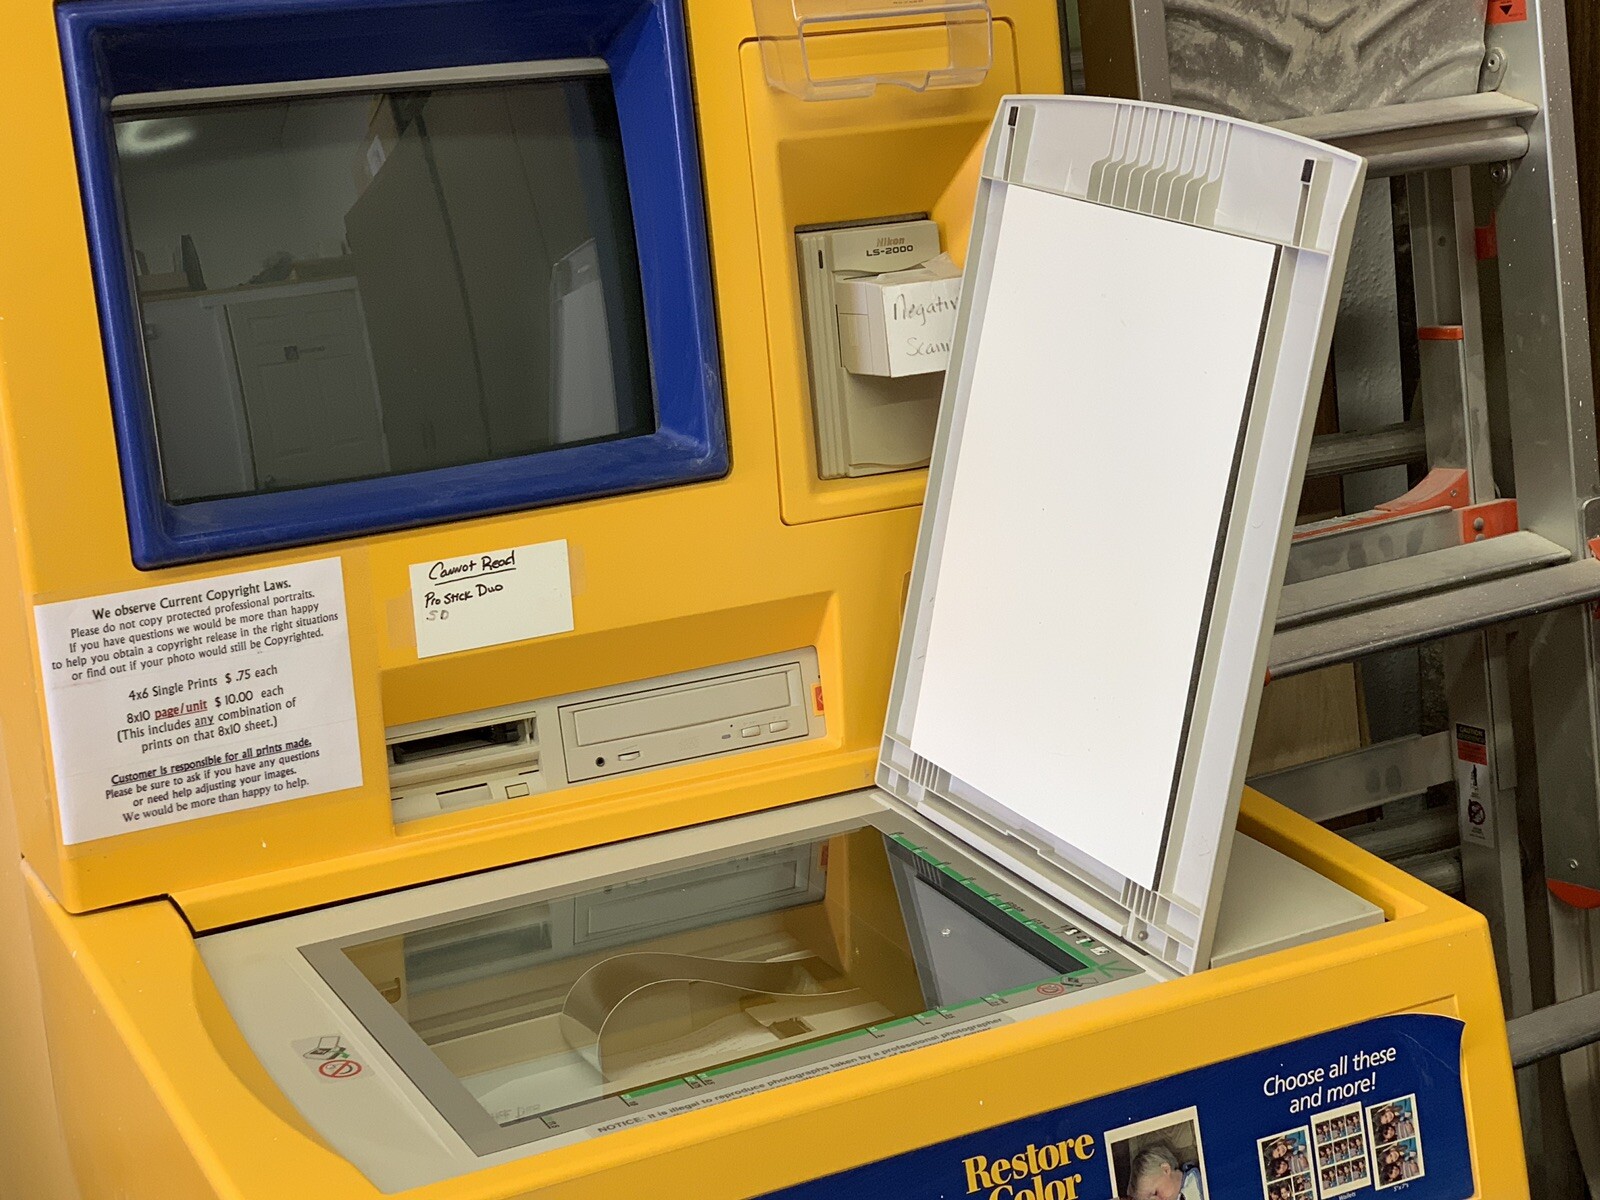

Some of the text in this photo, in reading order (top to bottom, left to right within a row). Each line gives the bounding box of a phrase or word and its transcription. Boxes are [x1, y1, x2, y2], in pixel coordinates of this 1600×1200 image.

[866, 245, 914, 257] LS-2000
[876, 237, 905, 247] Nikon
[428, 550, 516, 580] Cannot Read
[70, 589, 315, 638] Please do not copy protected professional portraits.
[91, 580, 291, 620] We observe Current Copyright Laws.
[424, 591, 441, 608] Pro
[51, 661, 62, 670] to
[65, 655, 87, 667] help
[90, 653, 109, 665] you
[112, 646, 144, 659] obtain
[156, 636, 202, 652] copyright
[205, 631, 237, 643] release
[240, 627, 249, 637] in
[252, 624, 267, 635] the
[270, 620, 293, 632] right
[295, 612, 338, 627] situations
[69, 603, 319, 653] If you have questions we would be more than happy
[71, 627, 323, 680] or find out if your photo would still be Copyrighted.
[126, 684, 284, 724] 8x10 page/unit $ 10.00 each
[128, 664, 277, 700] 4x6 Single Prints $ .75 each
[116, 696, 296, 743] (This includes any combination of
[141, 715, 277, 753] prints on that 8x10 sheet.)
[105, 749, 320, 799] Please be sure to ask if you have any questions
[110, 737, 312, 786] Customer is responsible for all prints made.
[122, 777, 309, 822] We would be more than happy to help.
[132, 767, 297, 806] or need help adjusting your images.
[598, 1116, 645, 1133] NOTICE:
[669, 1101, 700, 1114] illegal
[701, 1097, 713, 1105] to
[714, 1084, 766, 1102] reproduce
[767, 1065, 829, 1086] photographs
[830, 1057, 858, 1069] taken
[858, 1053, 872, 1062] by
[881, 1035, 940, 1055] professional
[940, 1018, 1003, 1040] photographer
[1263, 1047, 1397, 1096] Choose all these
[1289, 1072, 1376, 1113] and more!
[961, 1134, 1095, 1194] Restore
